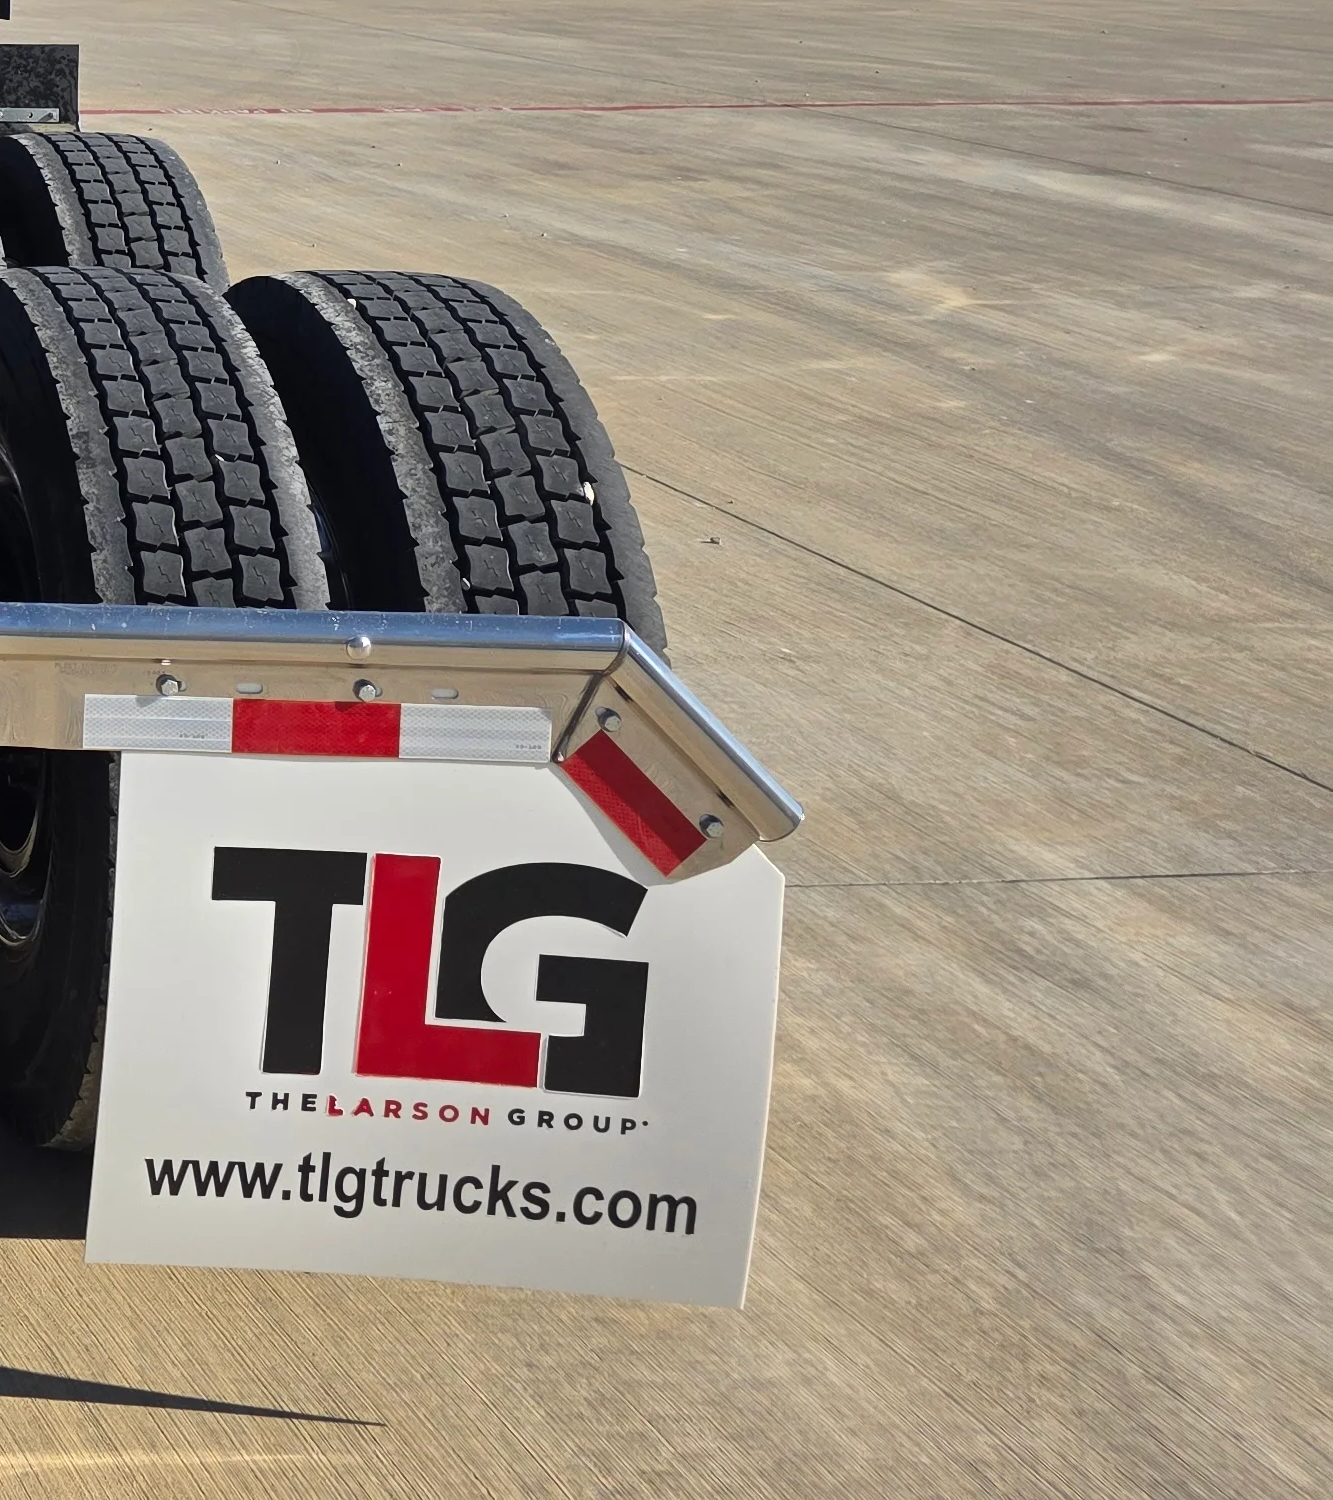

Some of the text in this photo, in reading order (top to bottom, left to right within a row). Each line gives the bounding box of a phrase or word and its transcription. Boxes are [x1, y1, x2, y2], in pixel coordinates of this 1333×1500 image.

[211, 846, 650, 1098] TLG
[507, 1108, 637, 1135] GROUP
[144, 1151, 697, 1236] www.tlgtrucks.com
